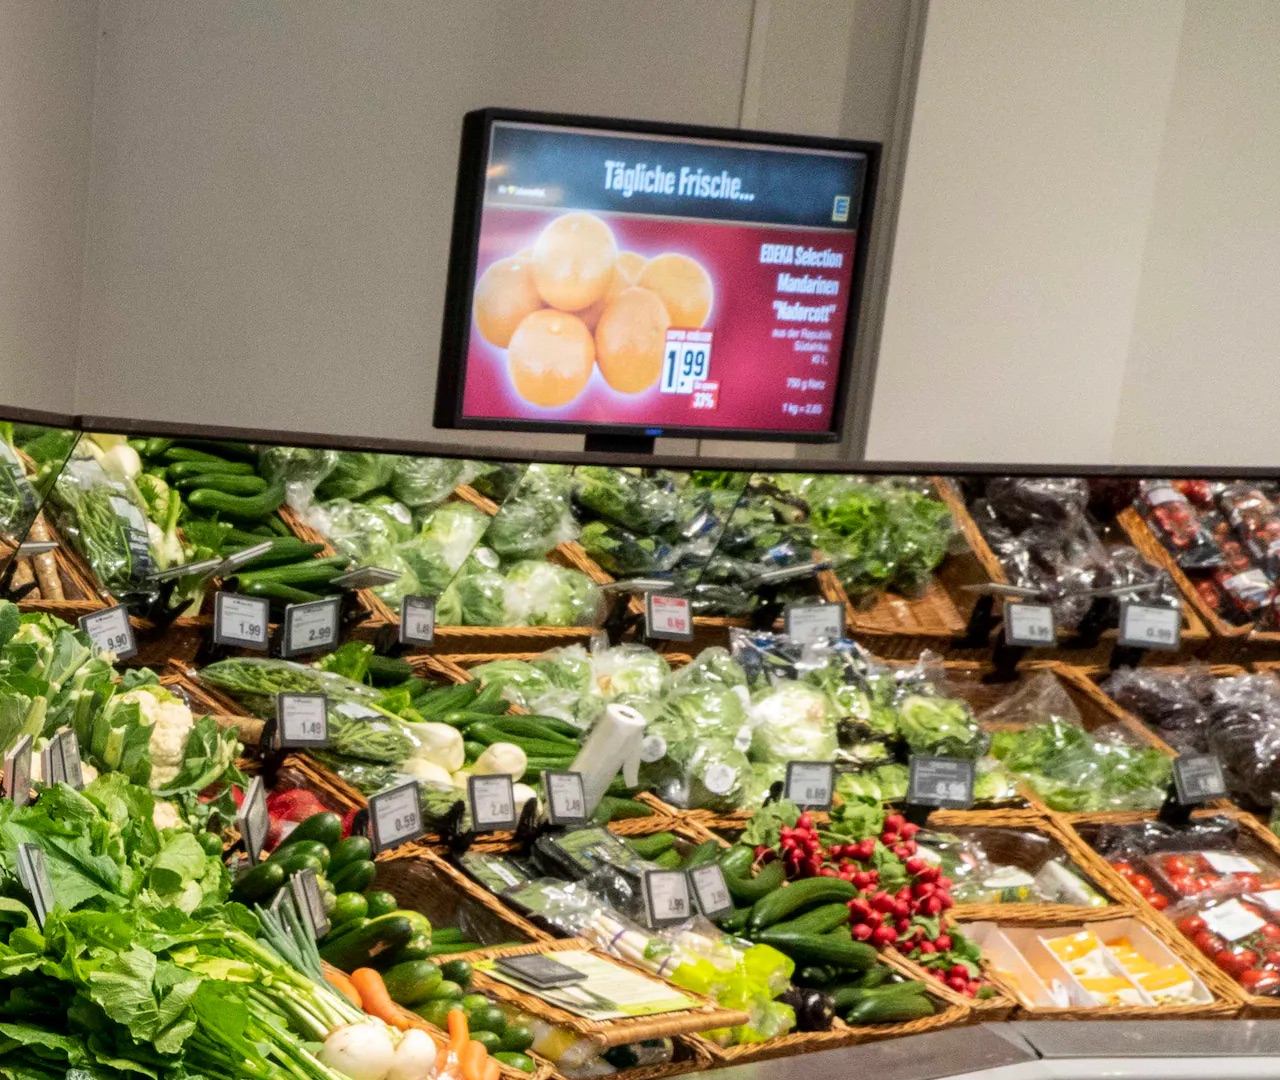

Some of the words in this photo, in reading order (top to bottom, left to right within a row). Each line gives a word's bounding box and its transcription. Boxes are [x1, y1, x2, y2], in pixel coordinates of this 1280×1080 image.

[604, 159, 675, 198] Tägliche
[678, 166, 755, 201] Frische...
[760, 244, 794, 265] EDEKA
[794, 246, 844, 268] Selection
[776, 272, 840, 296] Mandarinen
[668, 350, 705, 387] 1.99
